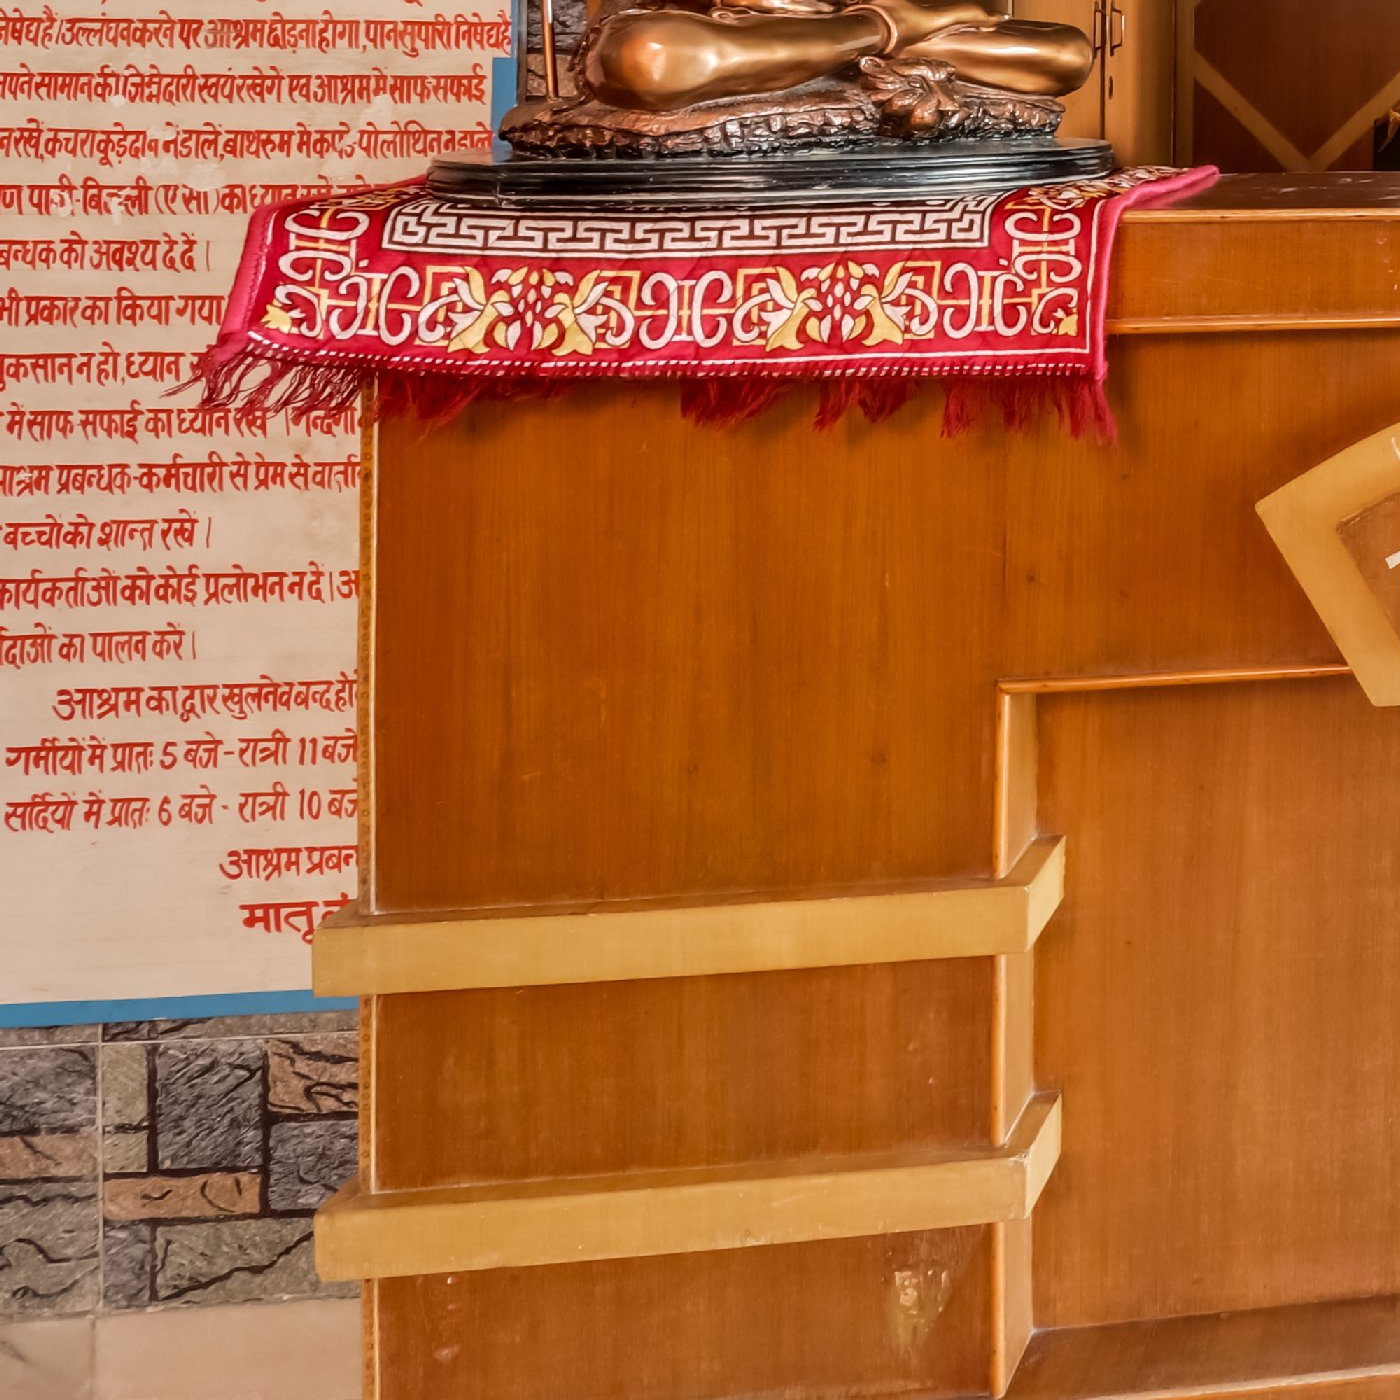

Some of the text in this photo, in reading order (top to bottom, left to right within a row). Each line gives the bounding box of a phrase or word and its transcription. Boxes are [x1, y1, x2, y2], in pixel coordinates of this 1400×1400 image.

[177, 18, 203, 49] पर
[204, 18, 268, 50] आश्रम
[364, 19, 400, 50] पान
[399, 13, 453, 58] सुपारी
[35, 72, 95, 102] सामान
[313, 75, 372, 105] आश्रम
[44, 128, 99, 159] कचरा
[58, 230, 89, 270] को
[89, 239, 161, 273] अवश्य
[24, 296, 82, 329] प्रकार
[81, 296, 113, 326] का
[114, 285, 176, 328] किया
[144, 408, 175, 439] का
[229, 451, 311, 493] से प्रेम से
[62, 513, 95, 550] को
[97, 518, 158, 552] शान्त
[120, 565, 156, 607] को
[154, 563, 201, 608] कोई
[202, 563, 289, 607] प्रलोभन
[58, 633, 85, 664] का
[89, 631, 152, 664] पालन
[51, 685, 144, 723] आश्रम
[147, 685, 179, 718] का
[180, 684, 220, 723] द्वार
[294, 680, 336, 712] बन्द
[298, 736, 318, 766] 11
[157, 794, 172, 827] 6
[178, 784, 218, 825] बजे
[298, 788, 322, 820] 10
[219, 848, 303, 881] आश्रम
